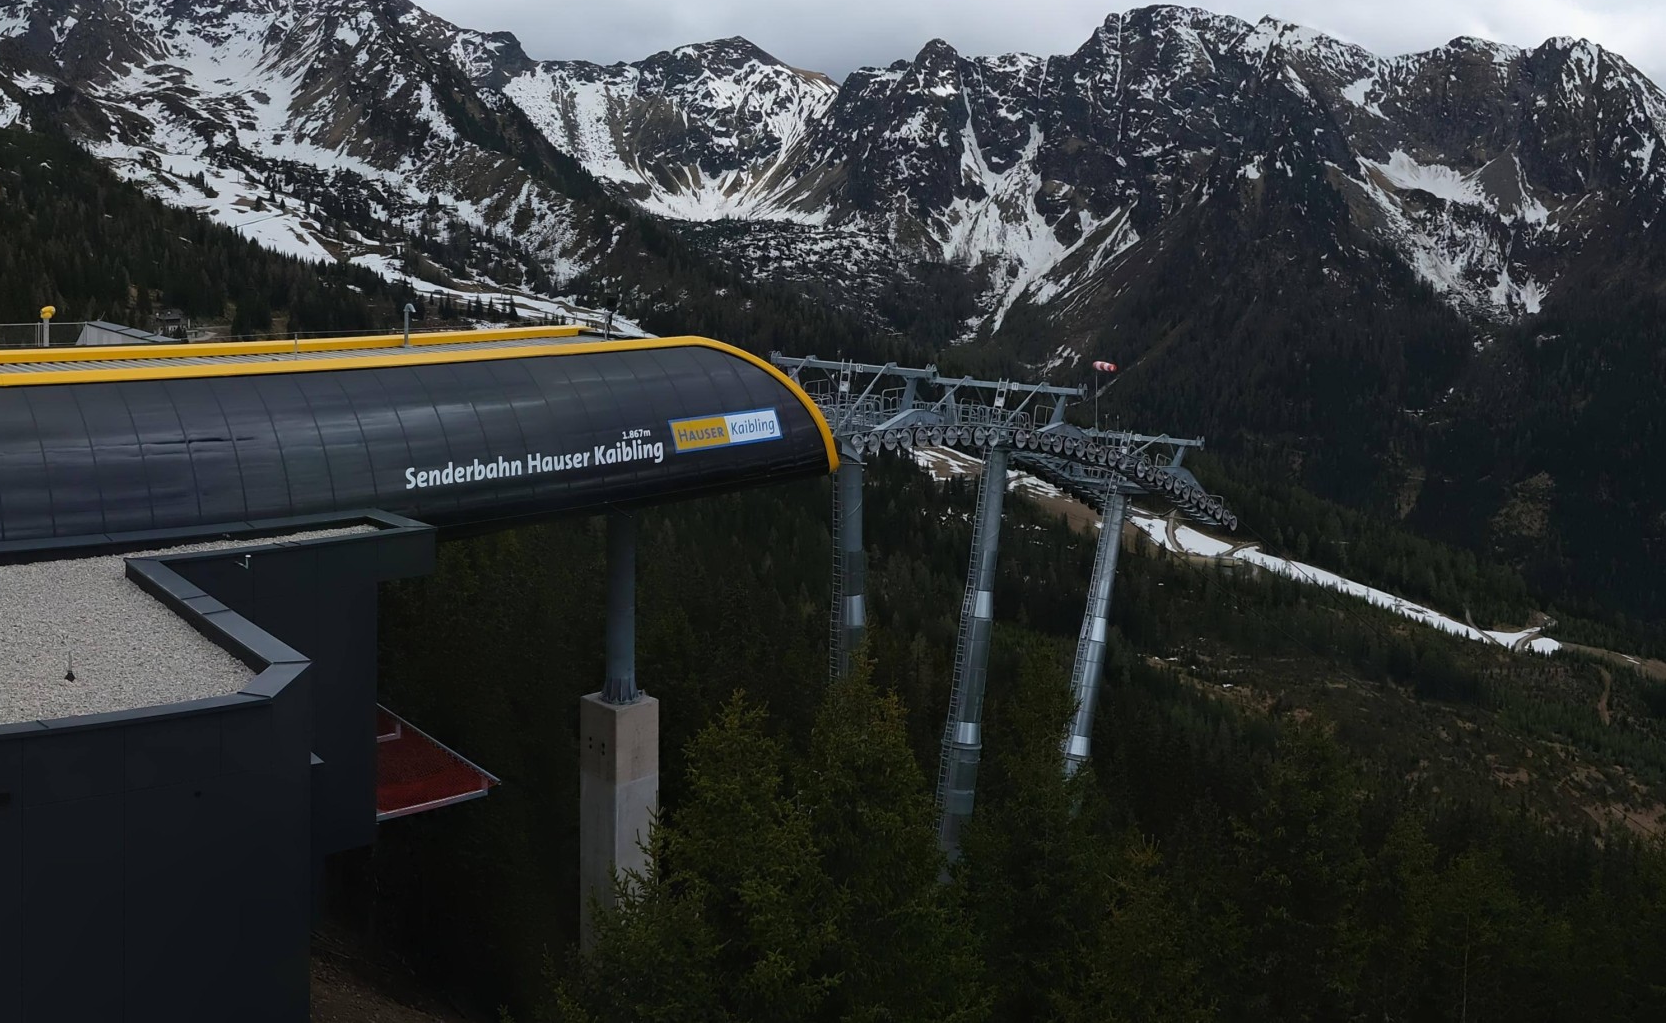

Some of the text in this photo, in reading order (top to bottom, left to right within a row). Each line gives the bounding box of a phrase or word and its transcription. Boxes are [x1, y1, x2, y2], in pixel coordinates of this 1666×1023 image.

[621, 429, 651, 440] 1.867m
[677, 418, 775, 443] HAUSER Kaibling
[405, 439, 664, 489] Senderbahn Hauser Kaibling
